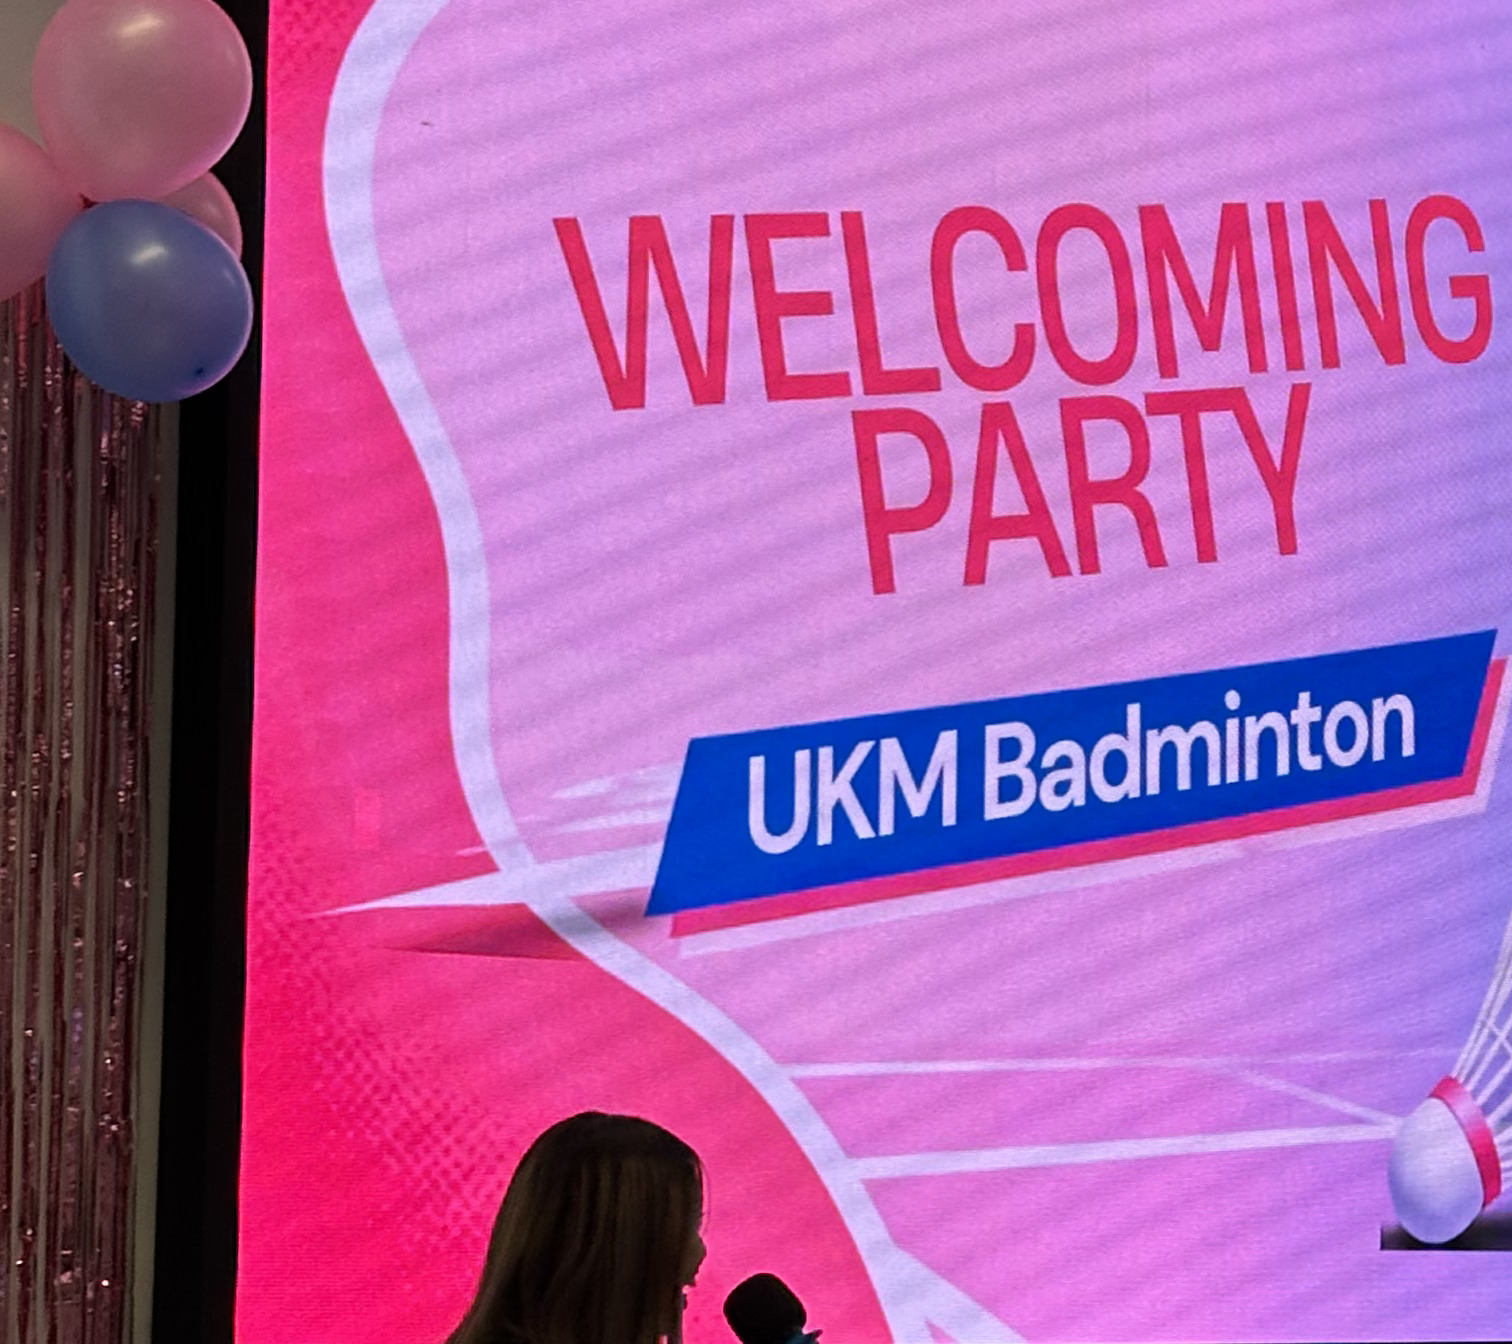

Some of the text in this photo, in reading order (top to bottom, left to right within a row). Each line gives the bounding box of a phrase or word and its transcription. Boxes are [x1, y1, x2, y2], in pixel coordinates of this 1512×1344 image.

[552, 194, 1494, 411] WELCOMING
[851, 382, 1312, 595] PARTY
[748, 690, 1415, 854] UKM Badminton
